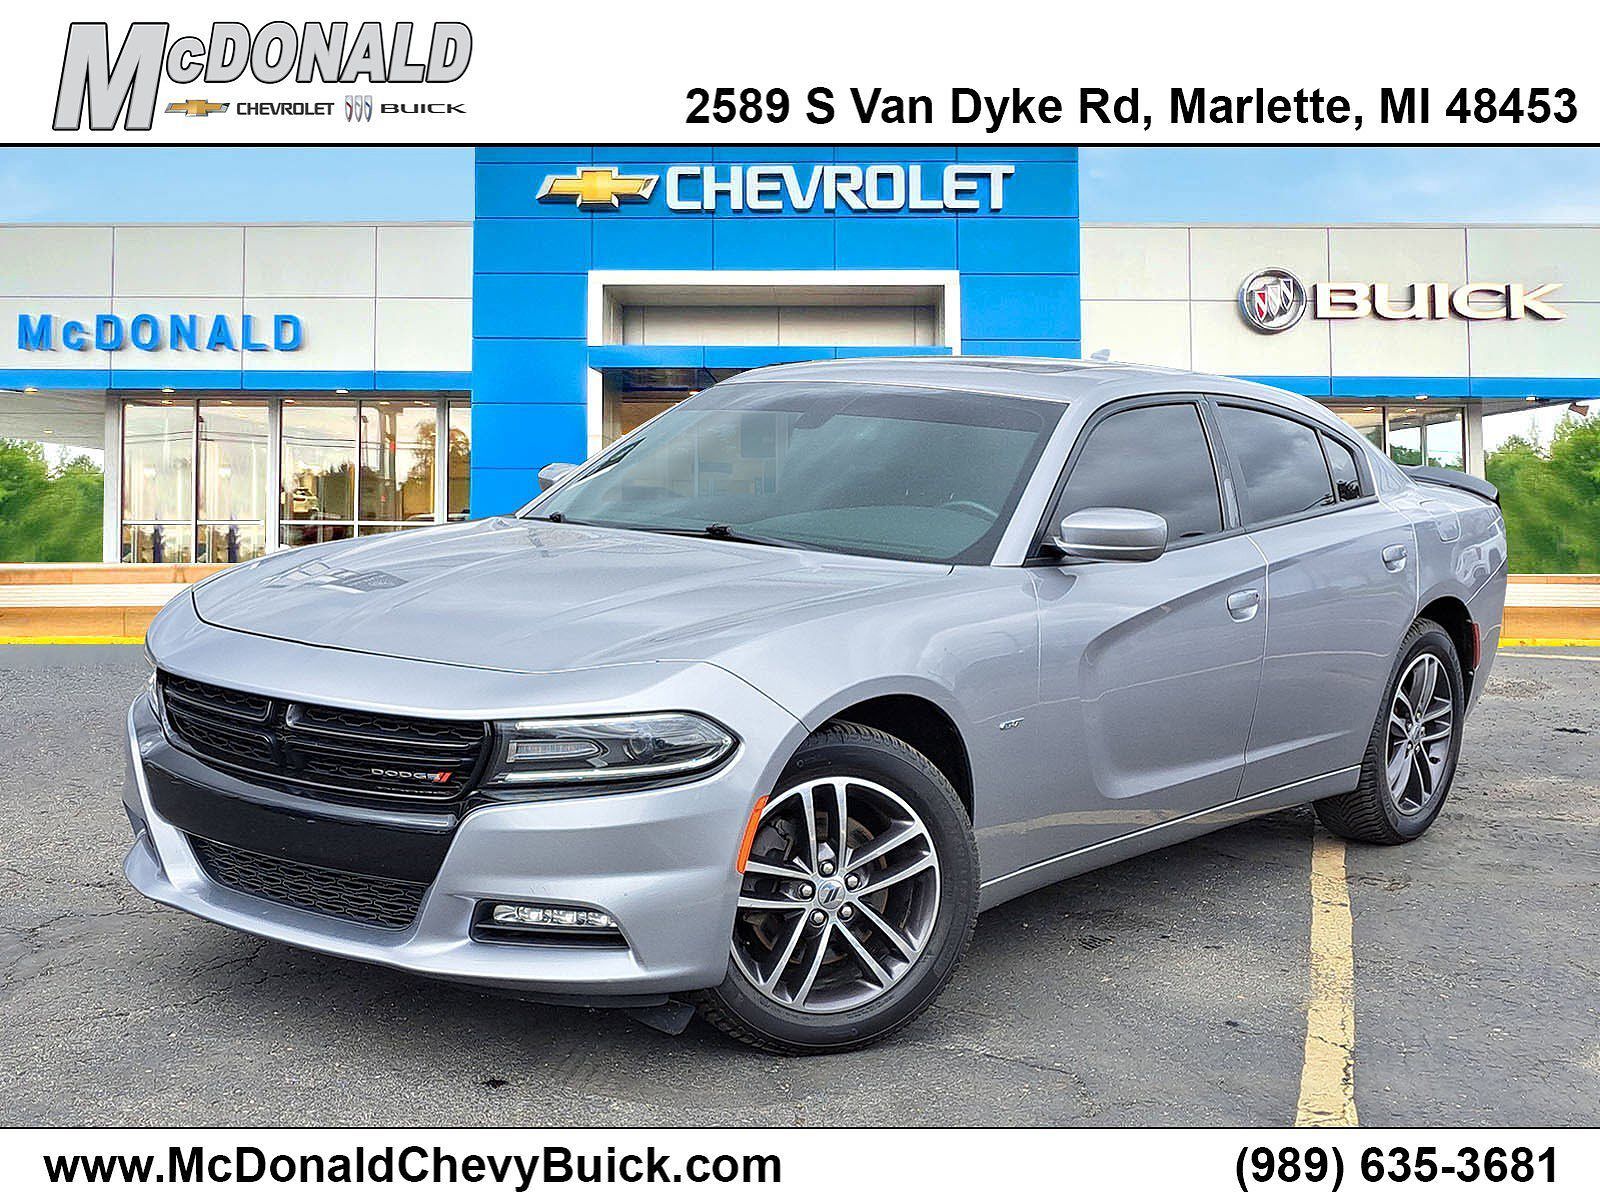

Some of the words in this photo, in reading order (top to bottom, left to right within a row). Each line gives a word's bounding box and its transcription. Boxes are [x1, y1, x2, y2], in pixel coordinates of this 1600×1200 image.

[666, 164, 1015, 212] CHEVROLET
[1313, 281, 1567, 321] BUICK
[18, 313, 304, 352] McDONALD
[370, 767, 441, 781] DODGE
